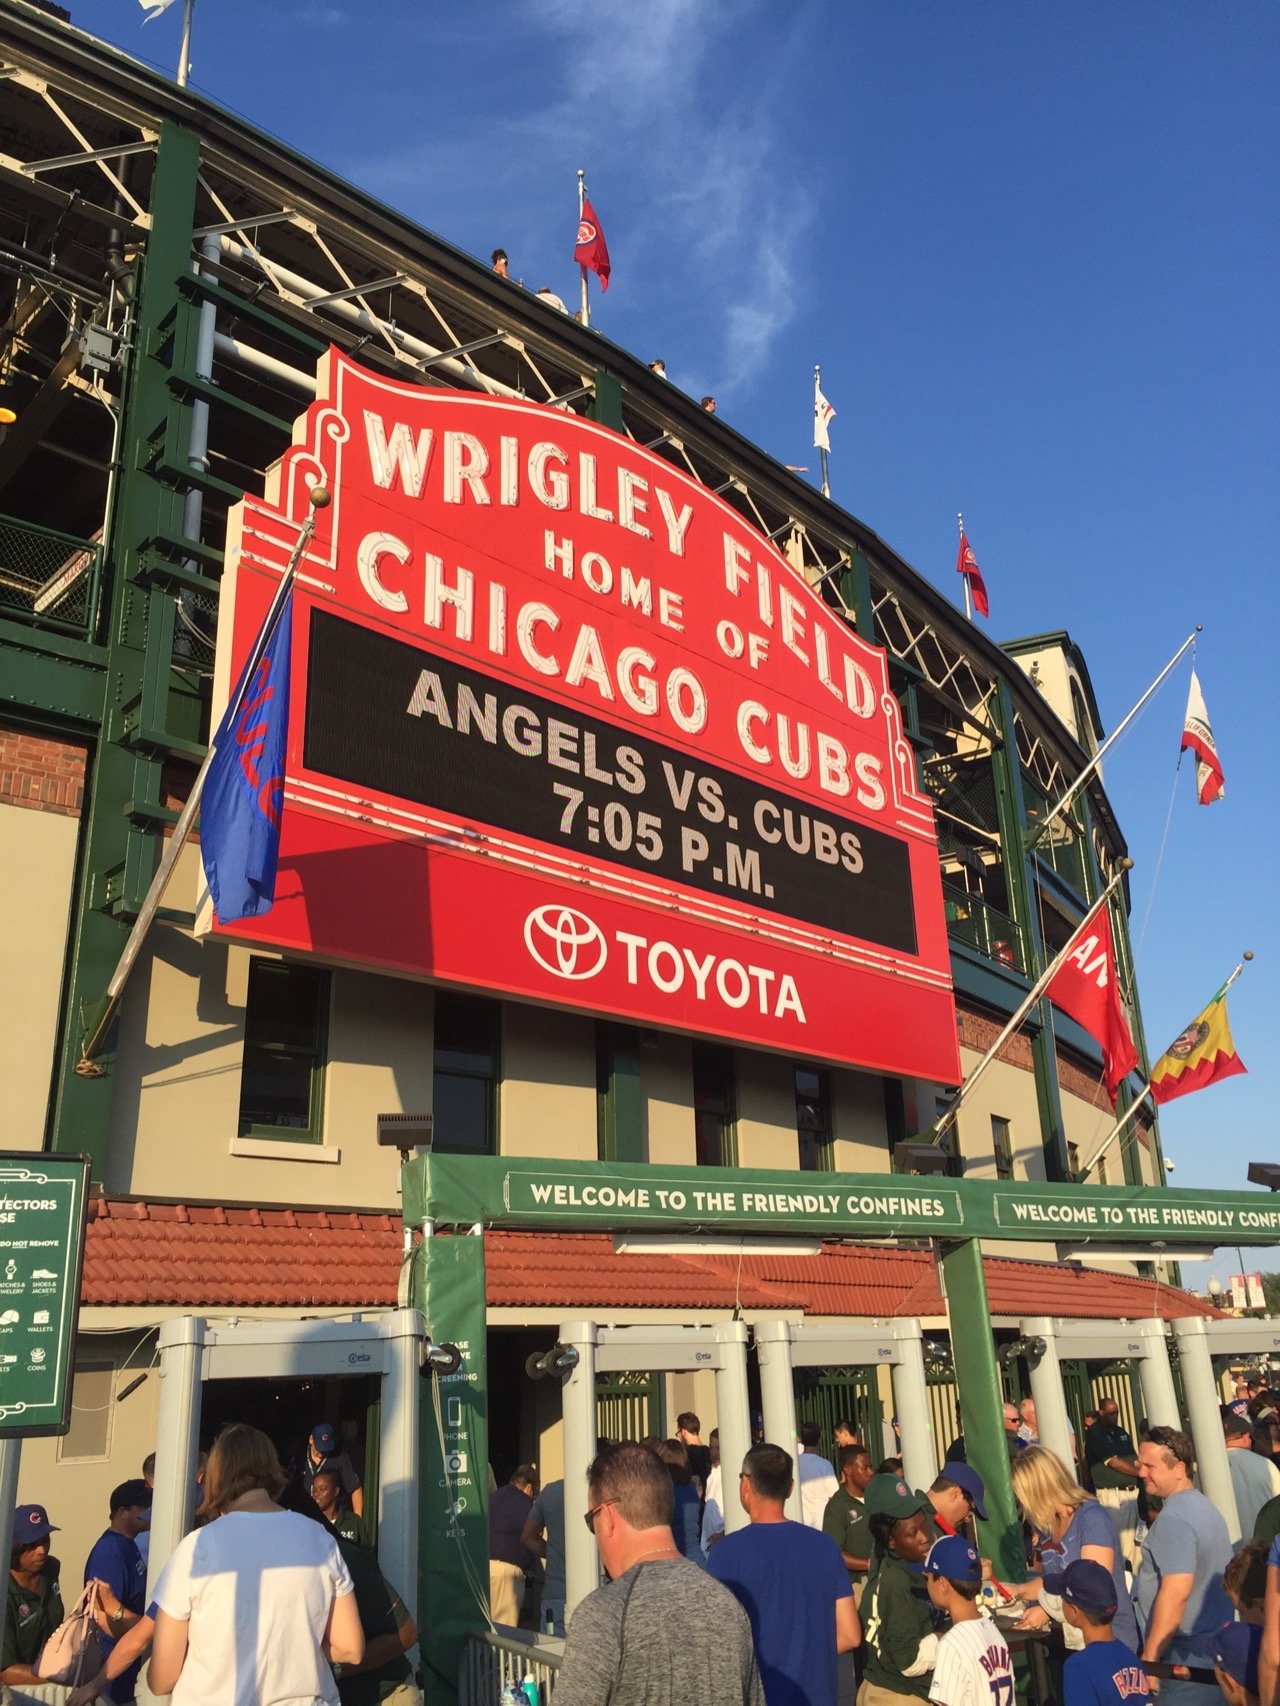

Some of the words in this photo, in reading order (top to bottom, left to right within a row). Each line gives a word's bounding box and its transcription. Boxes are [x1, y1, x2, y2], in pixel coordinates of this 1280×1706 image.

[363, 409, 693, 557] WRIGLEY
[723, 531, 877, 719] FIELD
[545, 529, 685, 633] HOME
[716, 620, 769, 670] OF
[357, 531, 708, 734] CHICAGO
[737, 700, 887, 811] CUBS
[406, 669, 646, 794] ANGELS
[661, 760, 739, 830] VS.
[753, 799, 865, 874] CUBS
[553, 782, 664, 861] 7:05
[681, 826, 775, 899] P.M.
[615, 931, 807, 1023] TOYOTA
[12, 1240, 28, 1248] NOT
[530, 1184, 650, 1208] WELCOME
[655, 1190, 687, 1210] TO
[692, 1192, 736, 1211] THE
[742, 1193, 840, 1214] FRIENDLY
[846, 1196, 945, 1217] CONFINES
[1012, 1203, 1097, 1223] WELCOME
[1101, 1206, 1123, 1224] TO
[1126, 1207, 1159, 1224] THE
[1163, 1208, 1234, 1227] FRIENDLY
